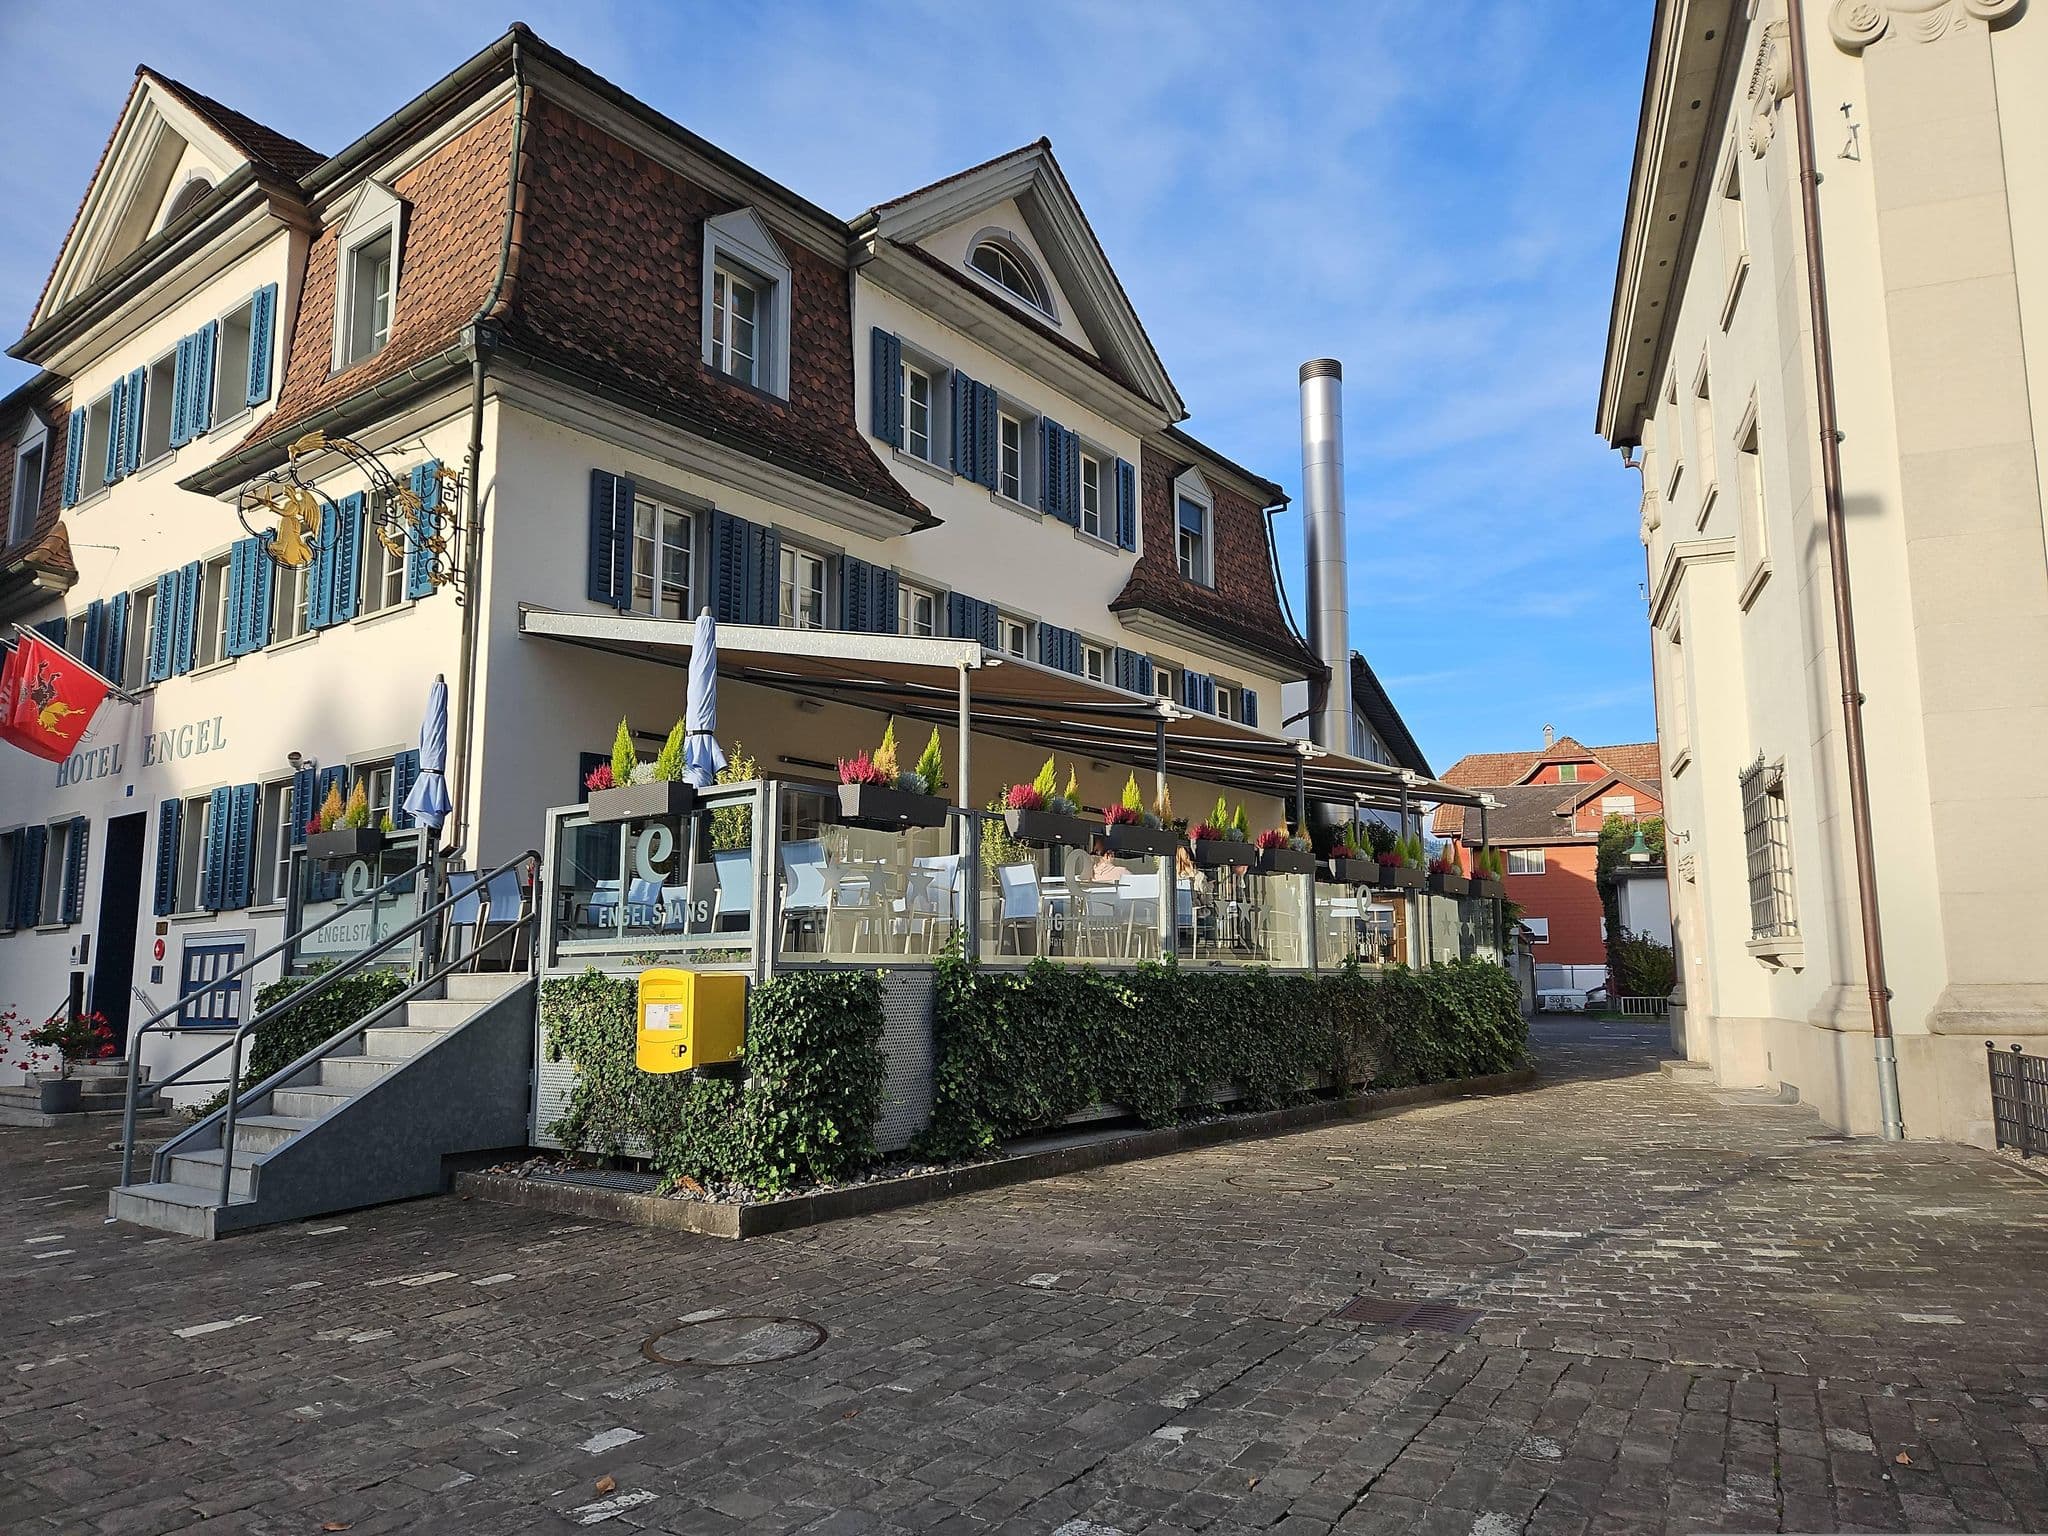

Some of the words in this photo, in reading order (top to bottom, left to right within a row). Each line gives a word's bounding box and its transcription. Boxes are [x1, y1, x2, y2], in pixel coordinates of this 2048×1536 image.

[56, 743, 122, 788] HOTEL
[142, 716, 227, 767] ENGEL
[318, 922, 389, 943] ENGELSTAS
